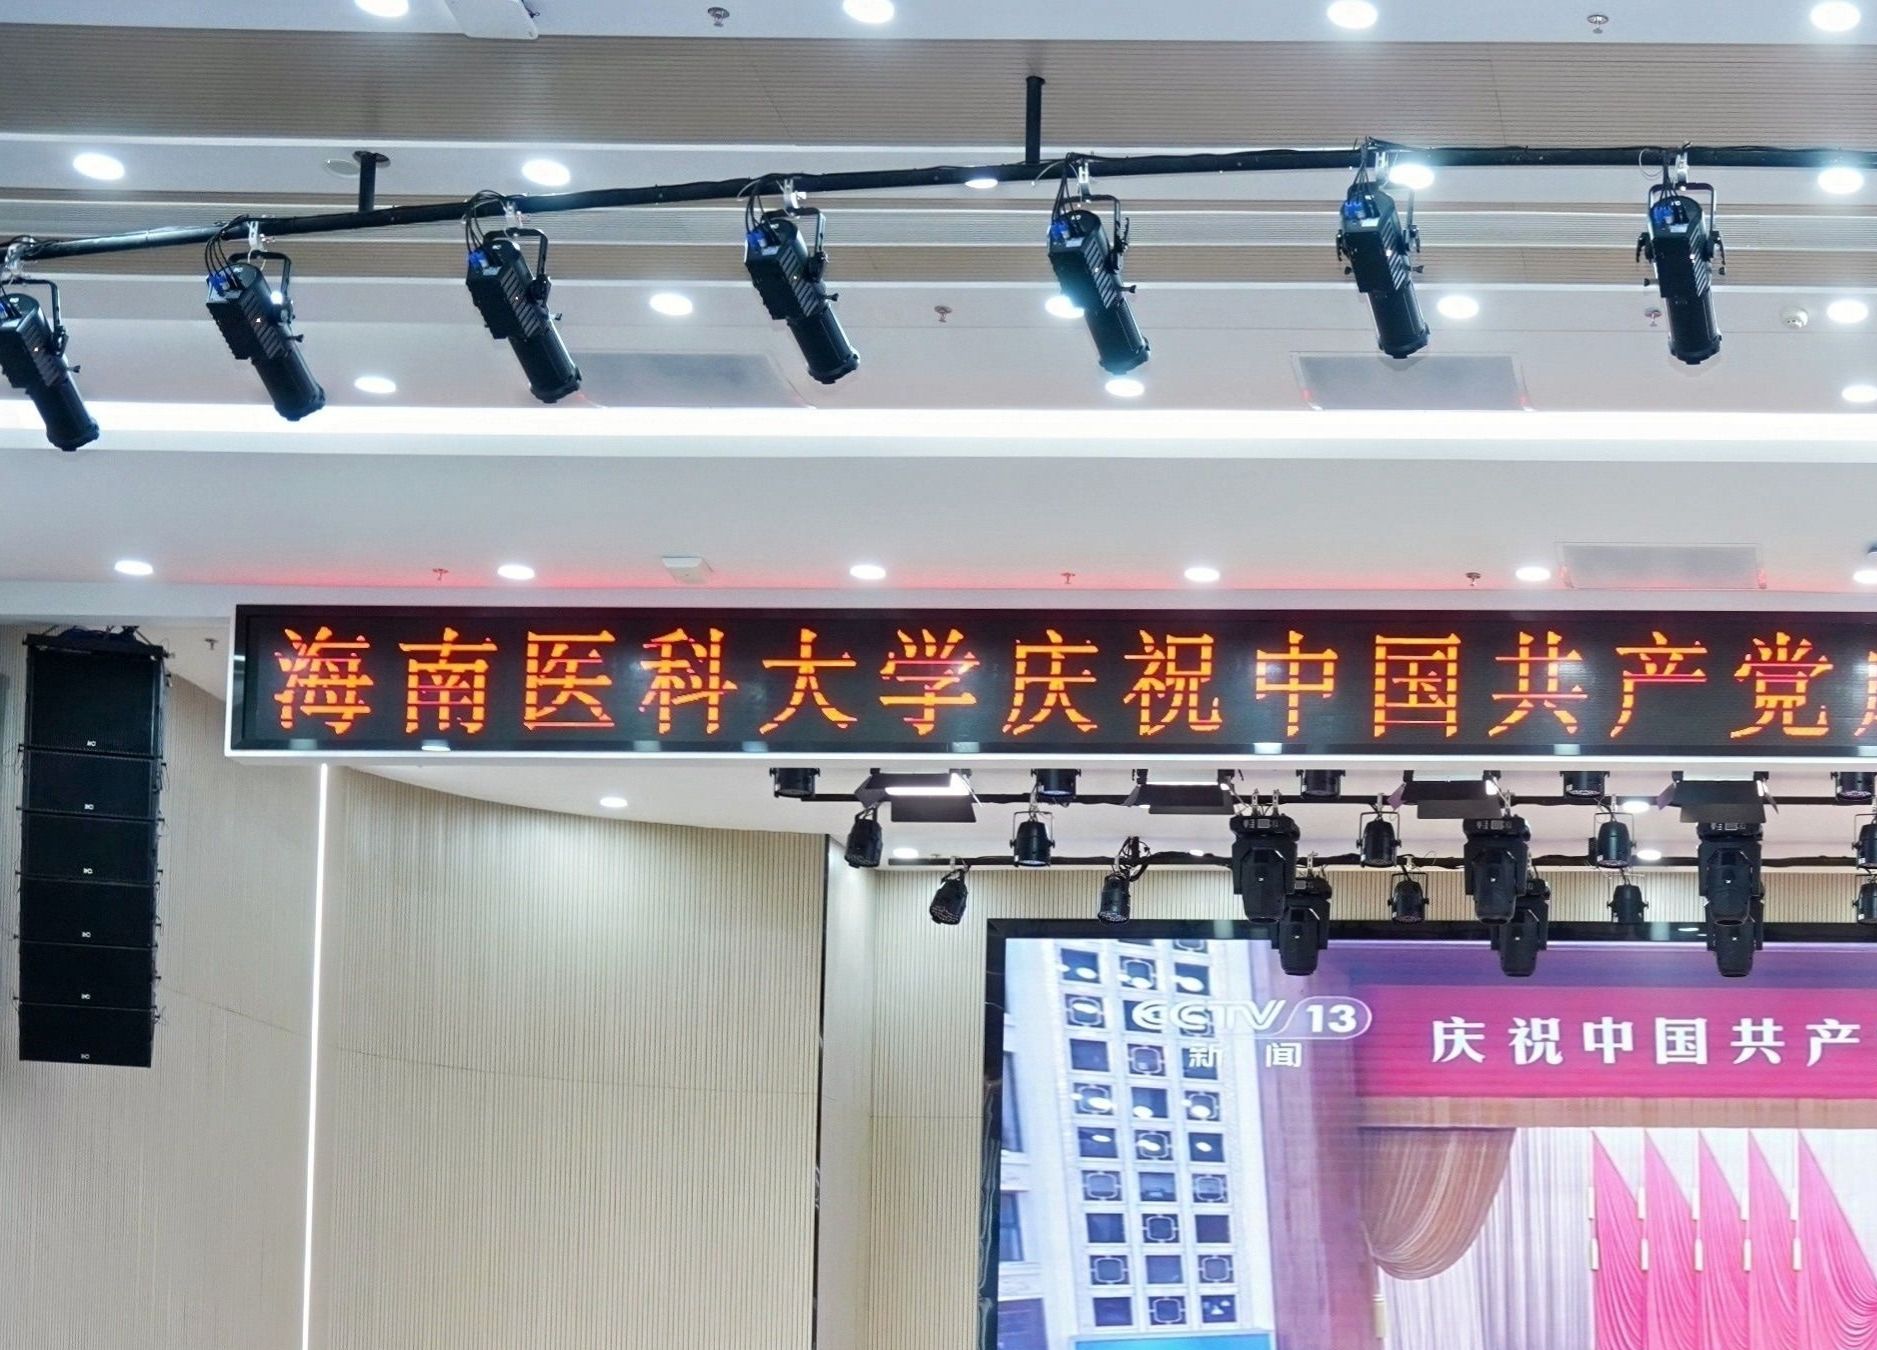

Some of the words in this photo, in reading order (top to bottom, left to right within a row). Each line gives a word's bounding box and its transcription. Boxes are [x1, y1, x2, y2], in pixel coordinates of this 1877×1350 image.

[1132, 1000, 1286, 1031] CCTV
[1306, 1004, 1357, 1033] 13
[1189, 1042, 1302, 1068] 新闻
